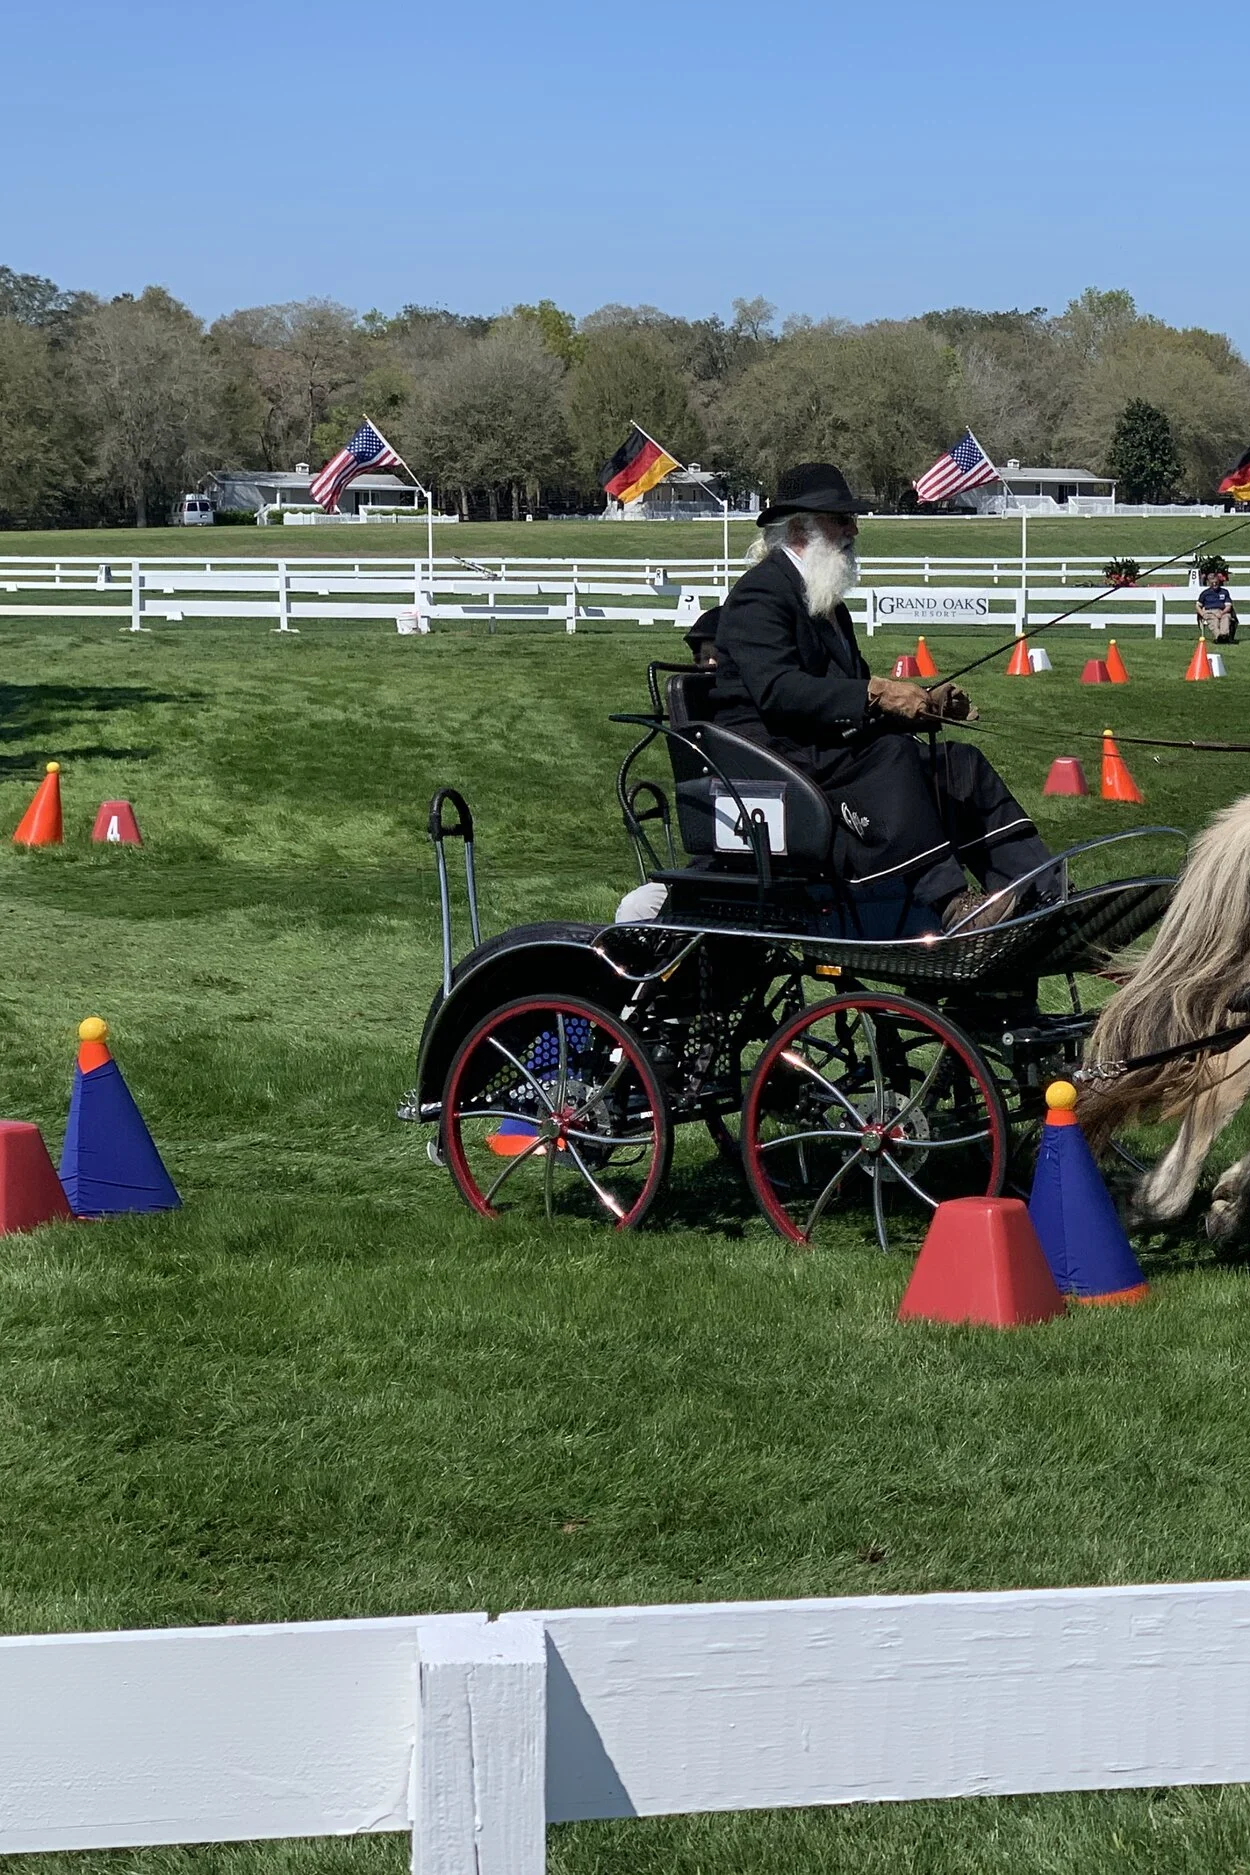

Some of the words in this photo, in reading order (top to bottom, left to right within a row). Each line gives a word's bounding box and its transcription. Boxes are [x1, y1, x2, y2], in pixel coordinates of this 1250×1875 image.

[1191, 570, 1197, 580] B
[879, 597, 937, 614] GRAND
[943, 598, 987, 615] OAKS
[895, 661, 903, 677] 5
[106, 815, 120, 842] 4
